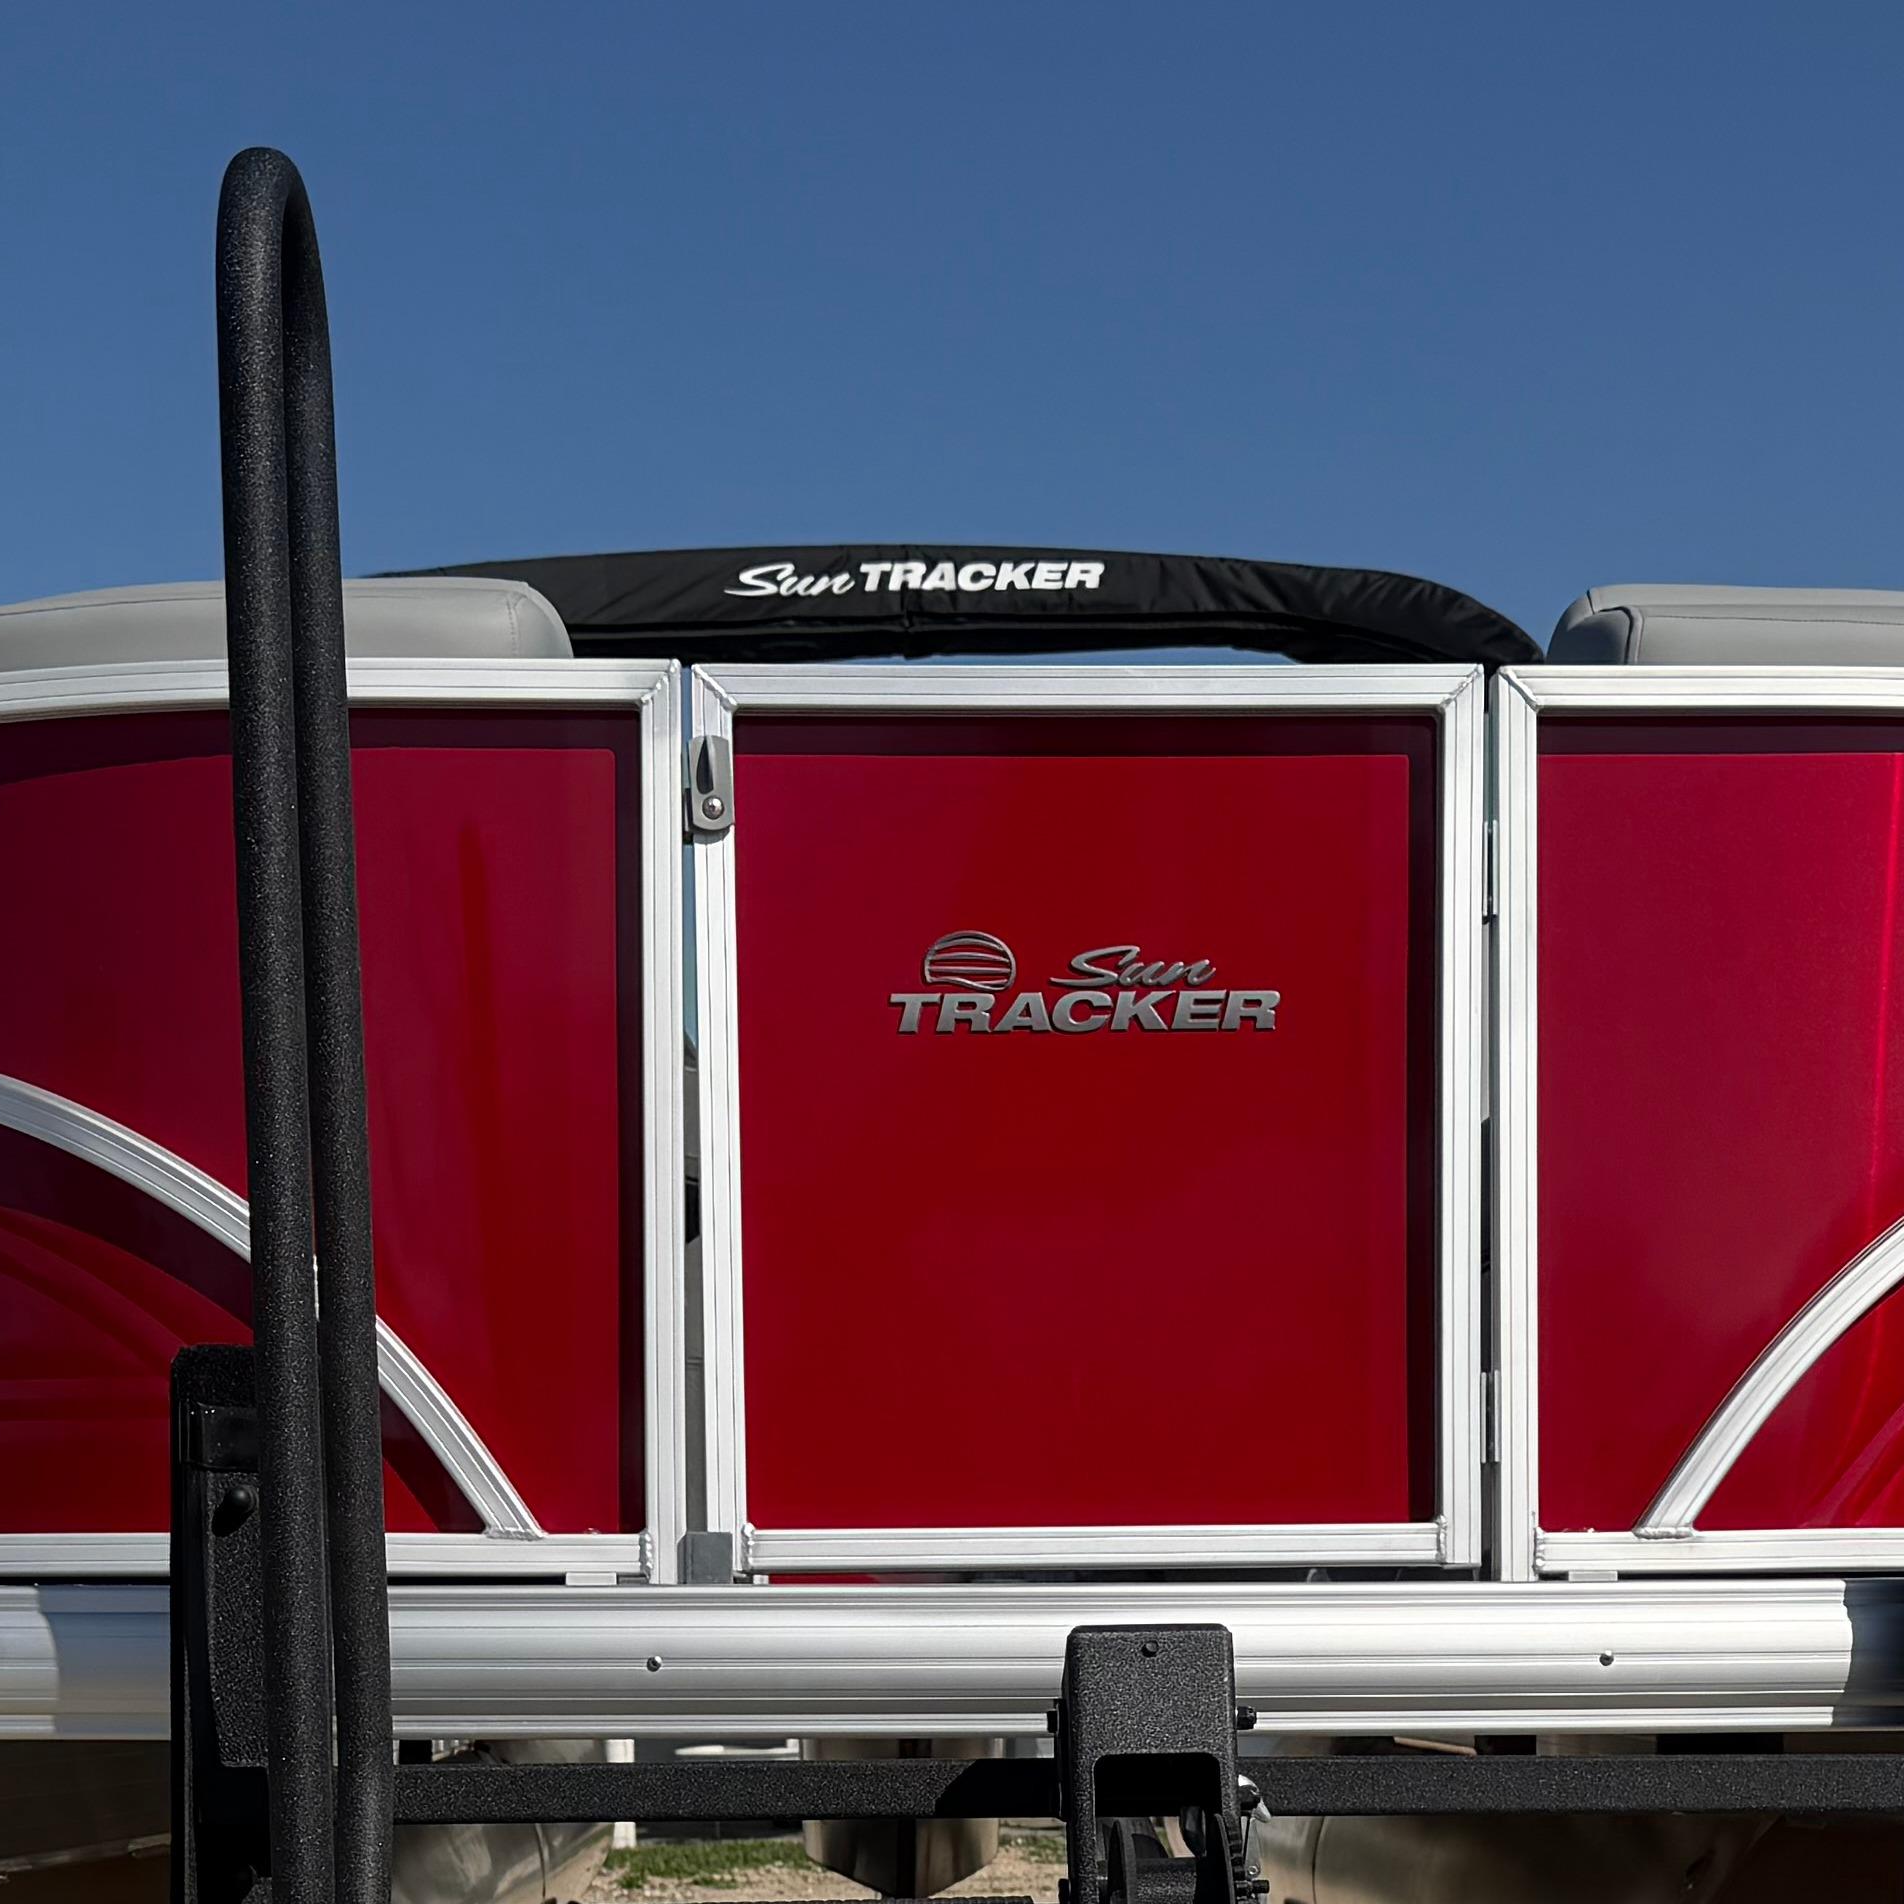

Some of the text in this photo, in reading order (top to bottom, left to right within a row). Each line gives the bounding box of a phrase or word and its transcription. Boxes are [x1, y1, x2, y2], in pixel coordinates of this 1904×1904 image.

[724, 561, 1106, 597] Sun TRACKER
[1050, 944, 1217, 987] Sun
[889, 989, 1281, 1034] TRACKER
